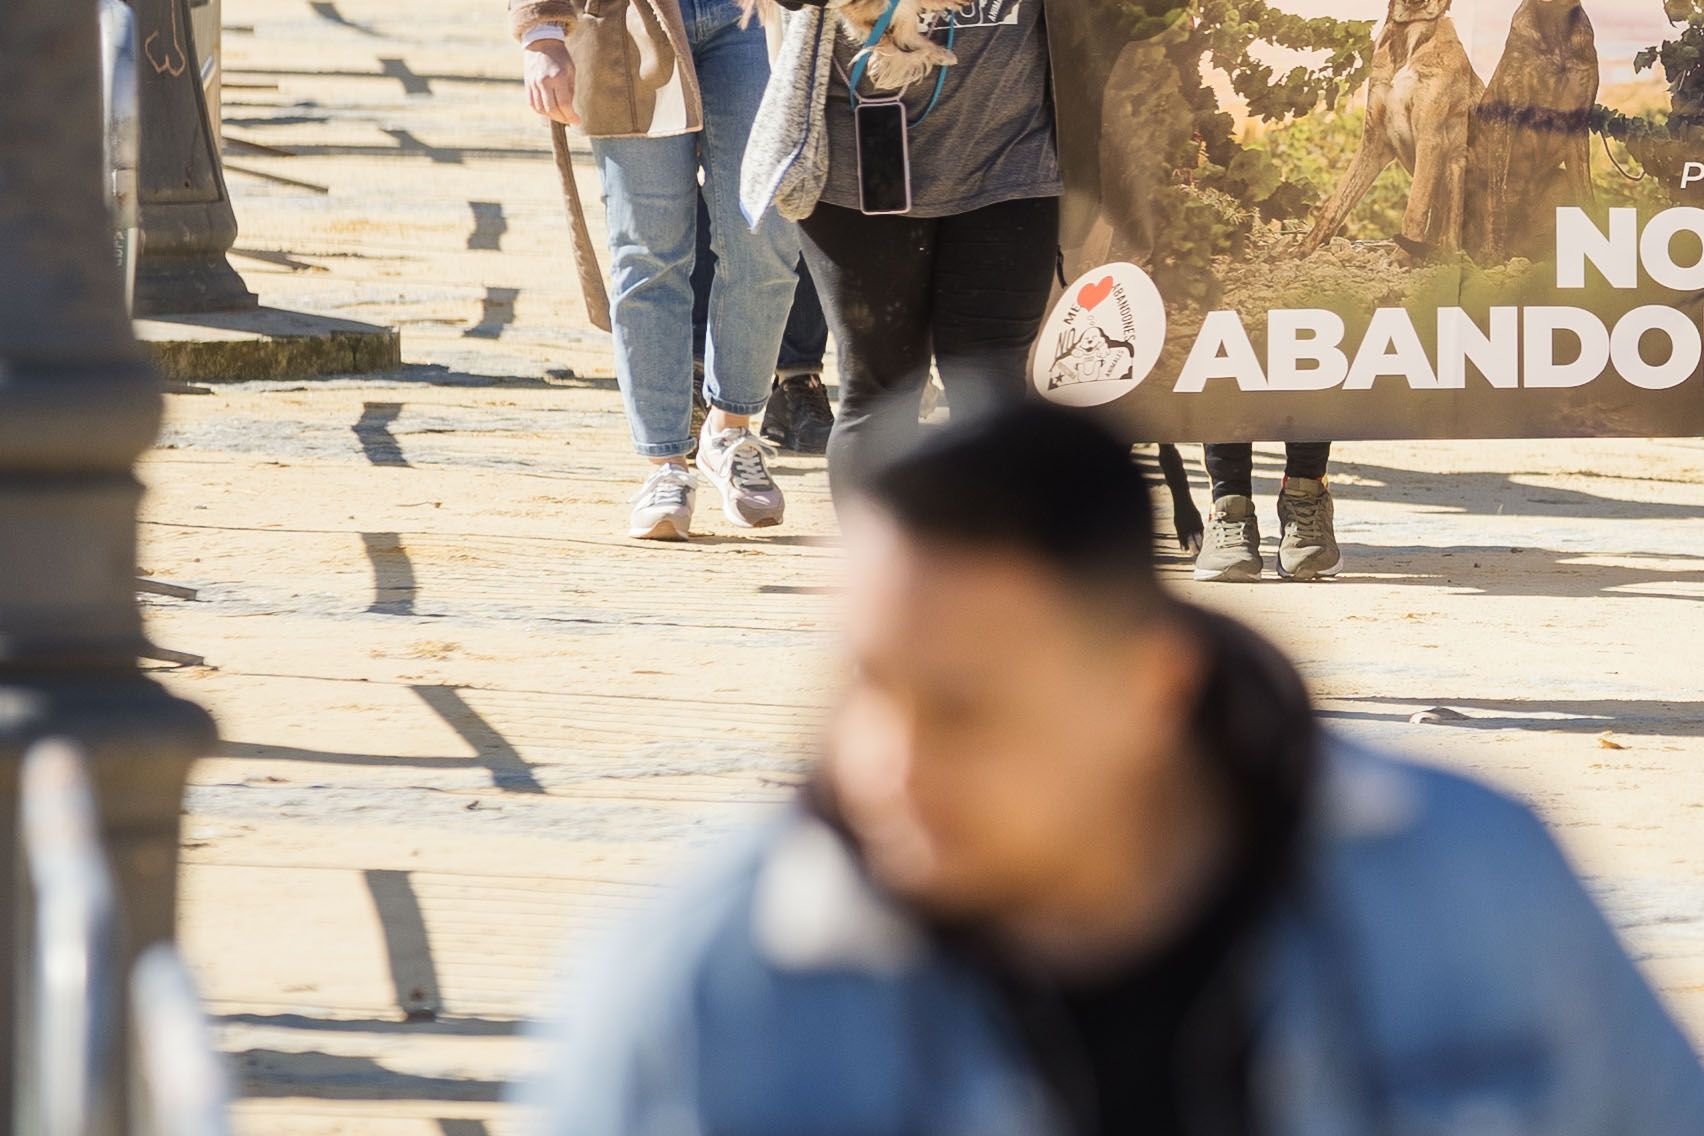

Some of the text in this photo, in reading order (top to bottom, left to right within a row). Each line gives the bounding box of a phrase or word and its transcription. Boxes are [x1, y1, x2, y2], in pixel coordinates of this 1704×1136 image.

[1054, 282, 1136, 361] NO ME ABANDONES
